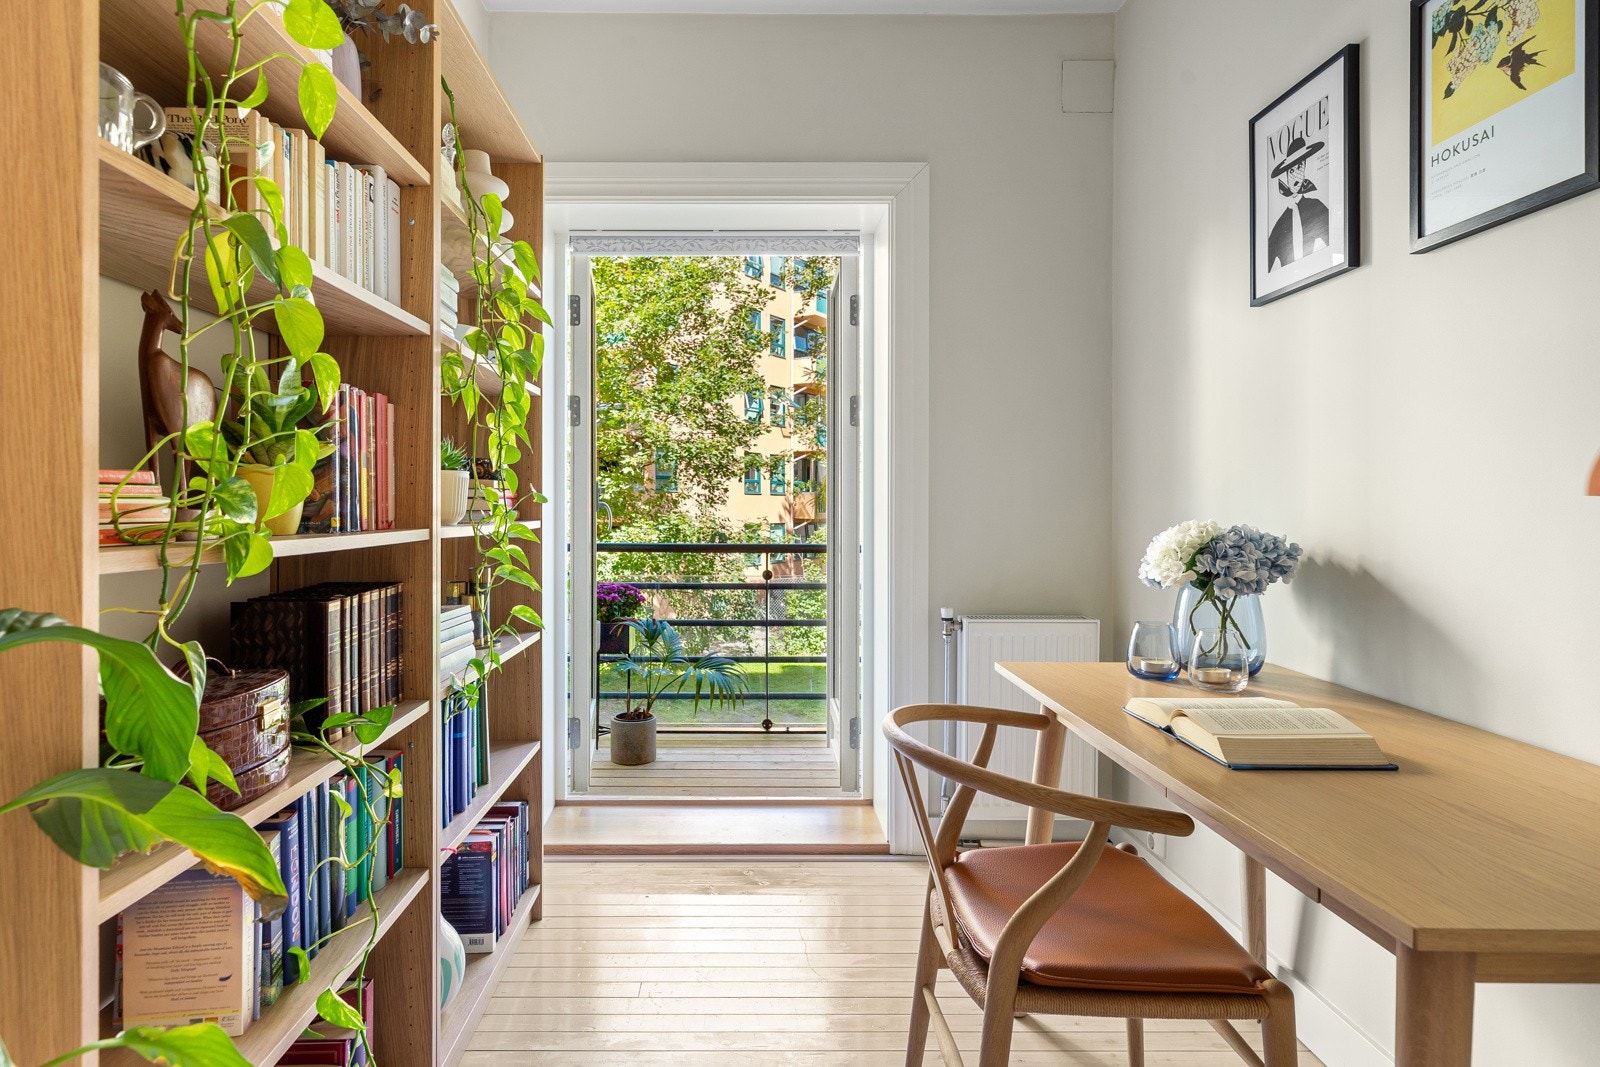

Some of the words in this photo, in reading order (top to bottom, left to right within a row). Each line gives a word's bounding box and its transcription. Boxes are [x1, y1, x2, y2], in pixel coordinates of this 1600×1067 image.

[167, 114, 192, 124] The
[1268, 95, 1329, 161] VOGUE
[1431, 125, 1495, 168] HOKUSAI
[290, 844, 301, 943] LONDON
